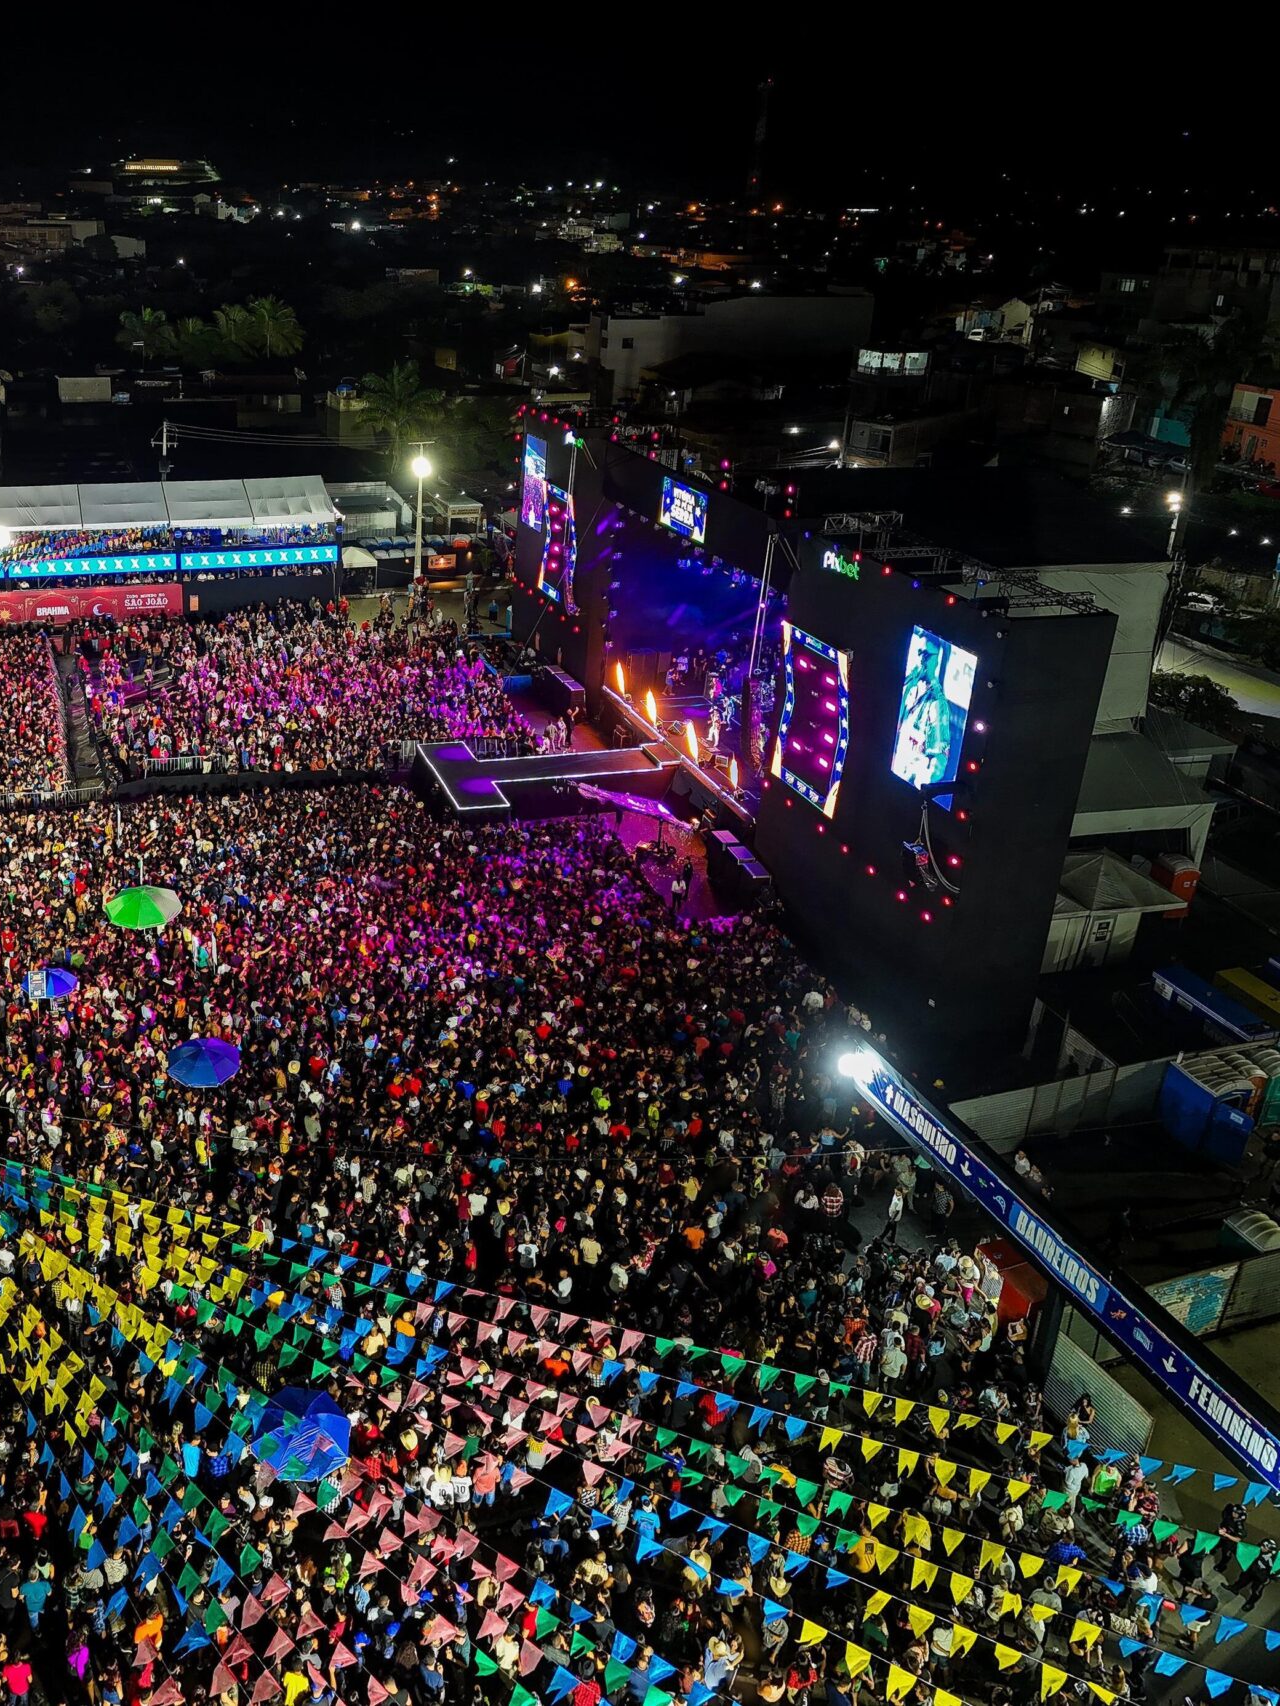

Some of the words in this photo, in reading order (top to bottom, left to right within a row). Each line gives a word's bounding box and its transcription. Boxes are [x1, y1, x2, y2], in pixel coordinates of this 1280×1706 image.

[823, 550, 860, 581] pixbet
[36, 605, 70, 616] BRAHMA
[893, 1090, 957, 1165] MASCULINO
[1015, 1209, 1100, 1304] BANHEIROS
[1188, 1374, 1278, 1473] FEMININO
